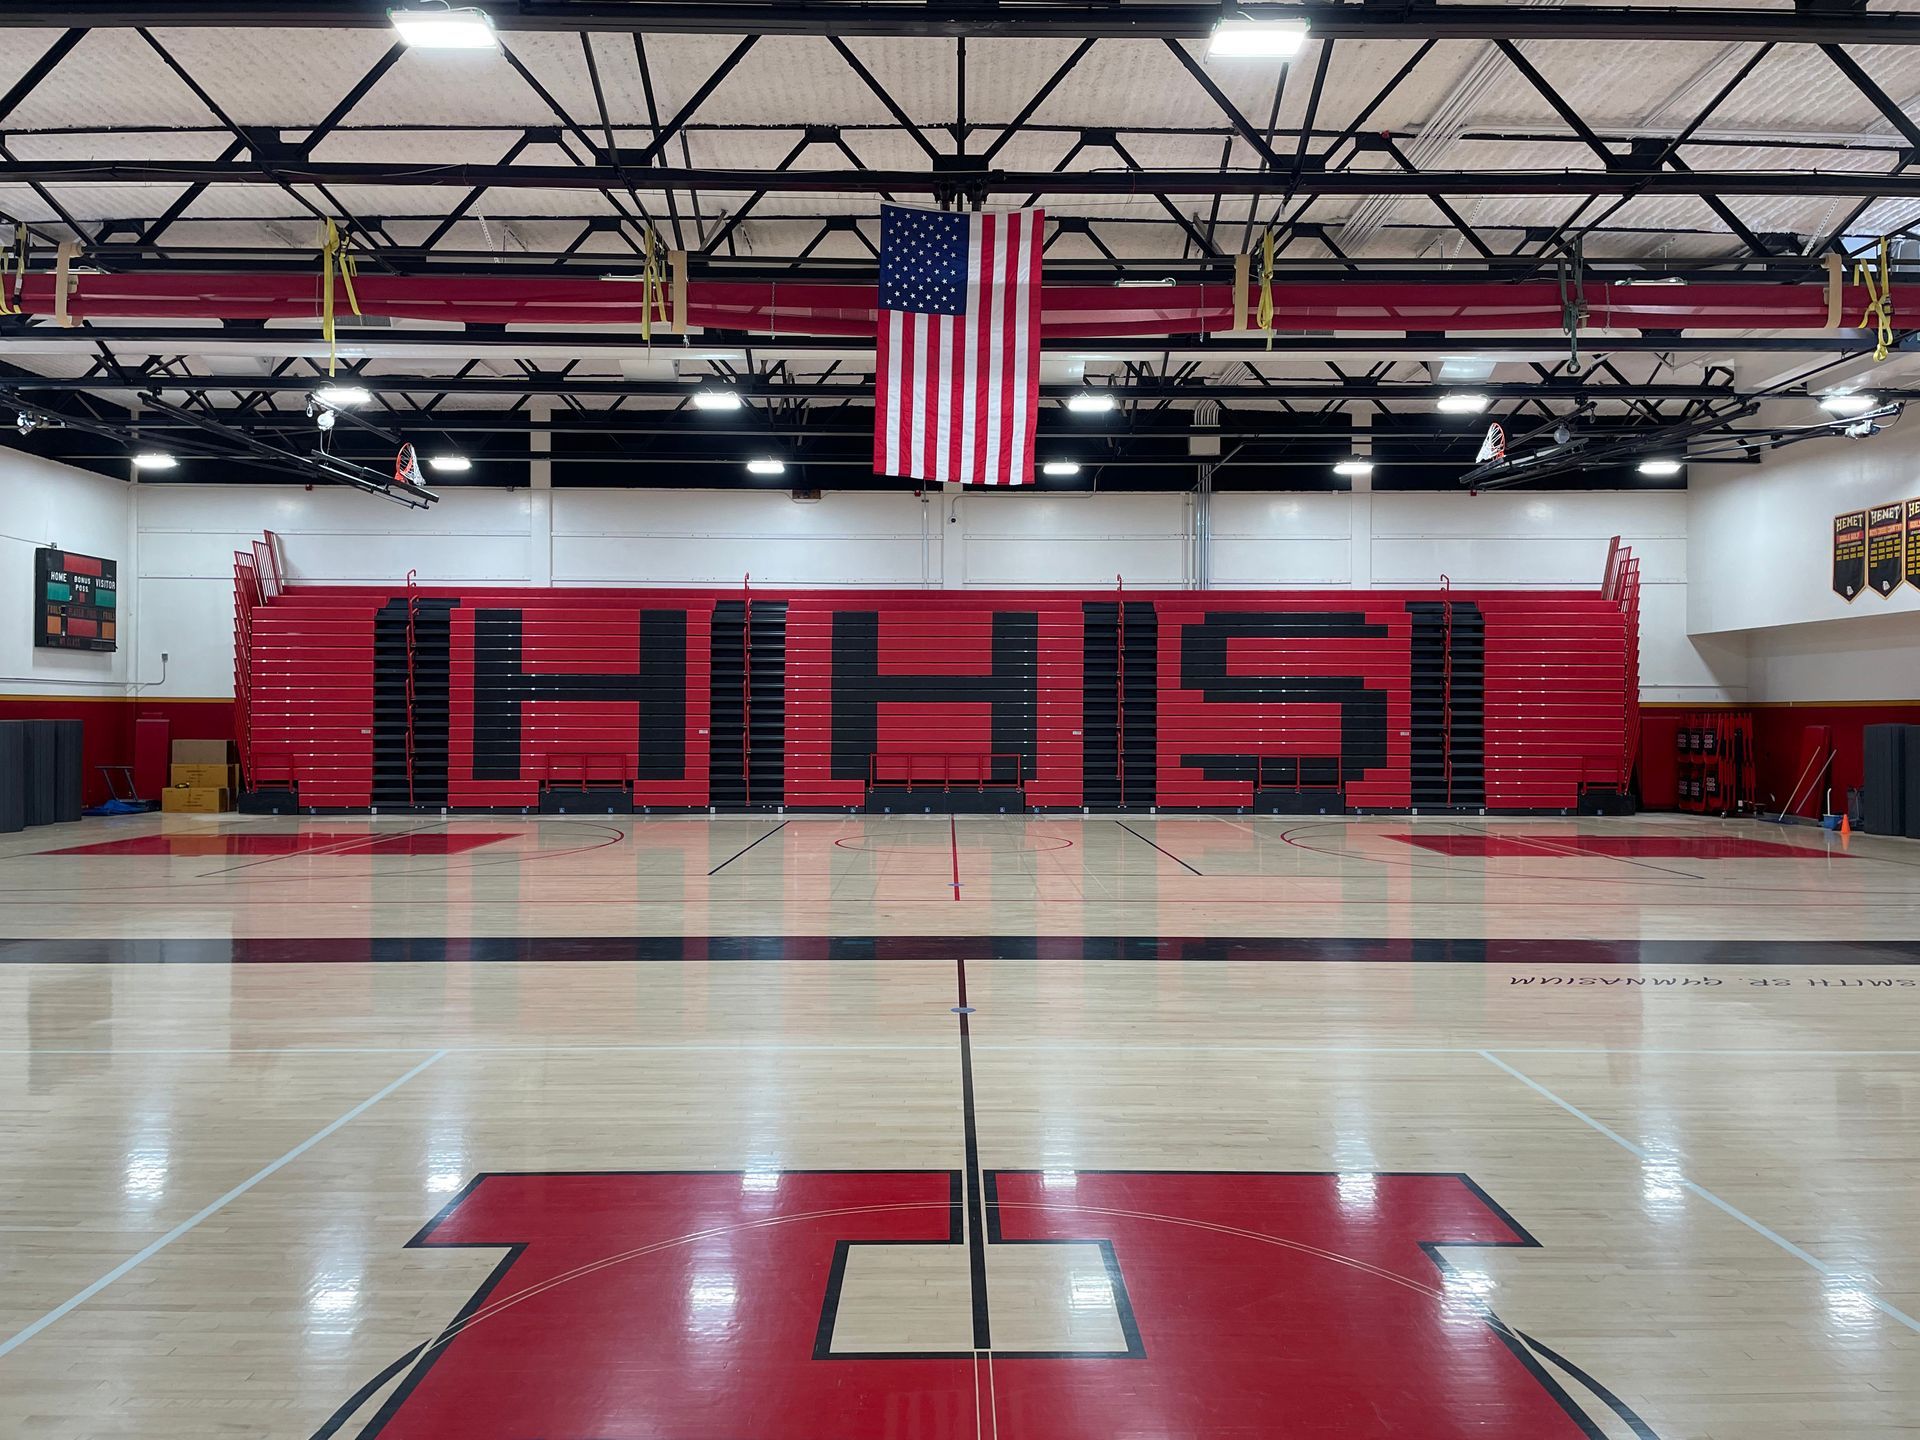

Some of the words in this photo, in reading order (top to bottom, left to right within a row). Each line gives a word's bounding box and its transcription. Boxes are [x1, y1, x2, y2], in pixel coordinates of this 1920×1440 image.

[1870, 505, 1900, 525] HEMET
[1836, 514, 1863, 532] HEMET
[51, 571, 67, 582] HOME
[74, 575, 91, 584] BONUS
[95, 578, 115, 590] VISITOR
[1509, 977, 1723, 985] GYMNASIUM
[1807, 979, 1916, 987] SMITH
